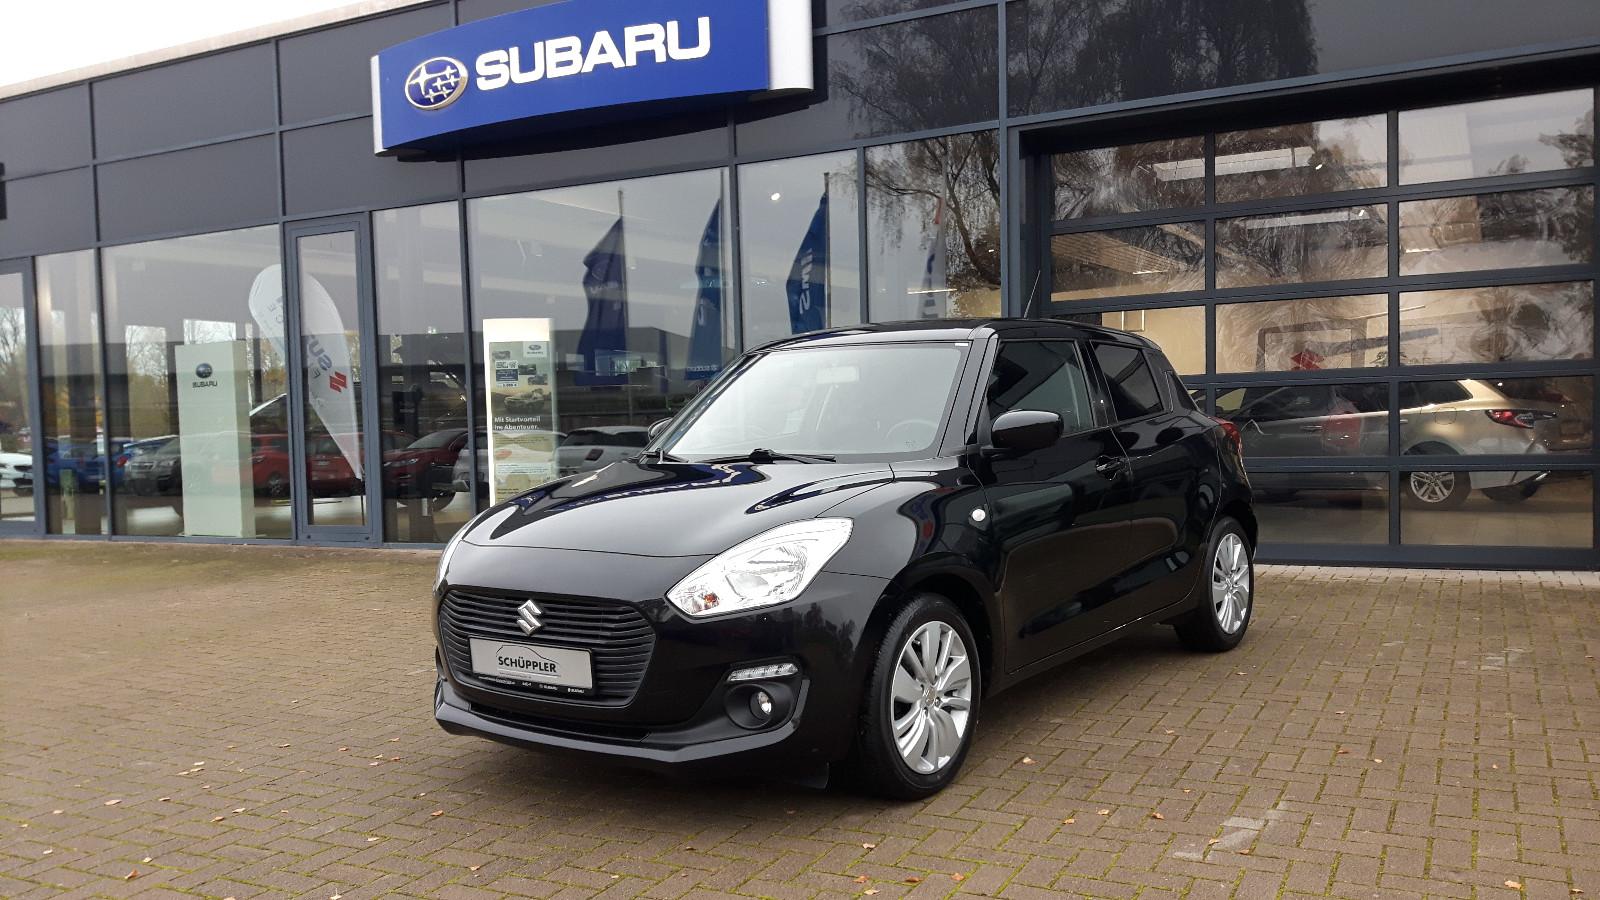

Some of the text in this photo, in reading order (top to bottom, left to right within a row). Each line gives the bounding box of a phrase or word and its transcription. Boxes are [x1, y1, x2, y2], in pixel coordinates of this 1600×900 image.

[475, 16, 711, 91] SUBARU
[192, 380, 218, 388] SUBARU
[498, 656, 557, 673] SCHÜPPLER
